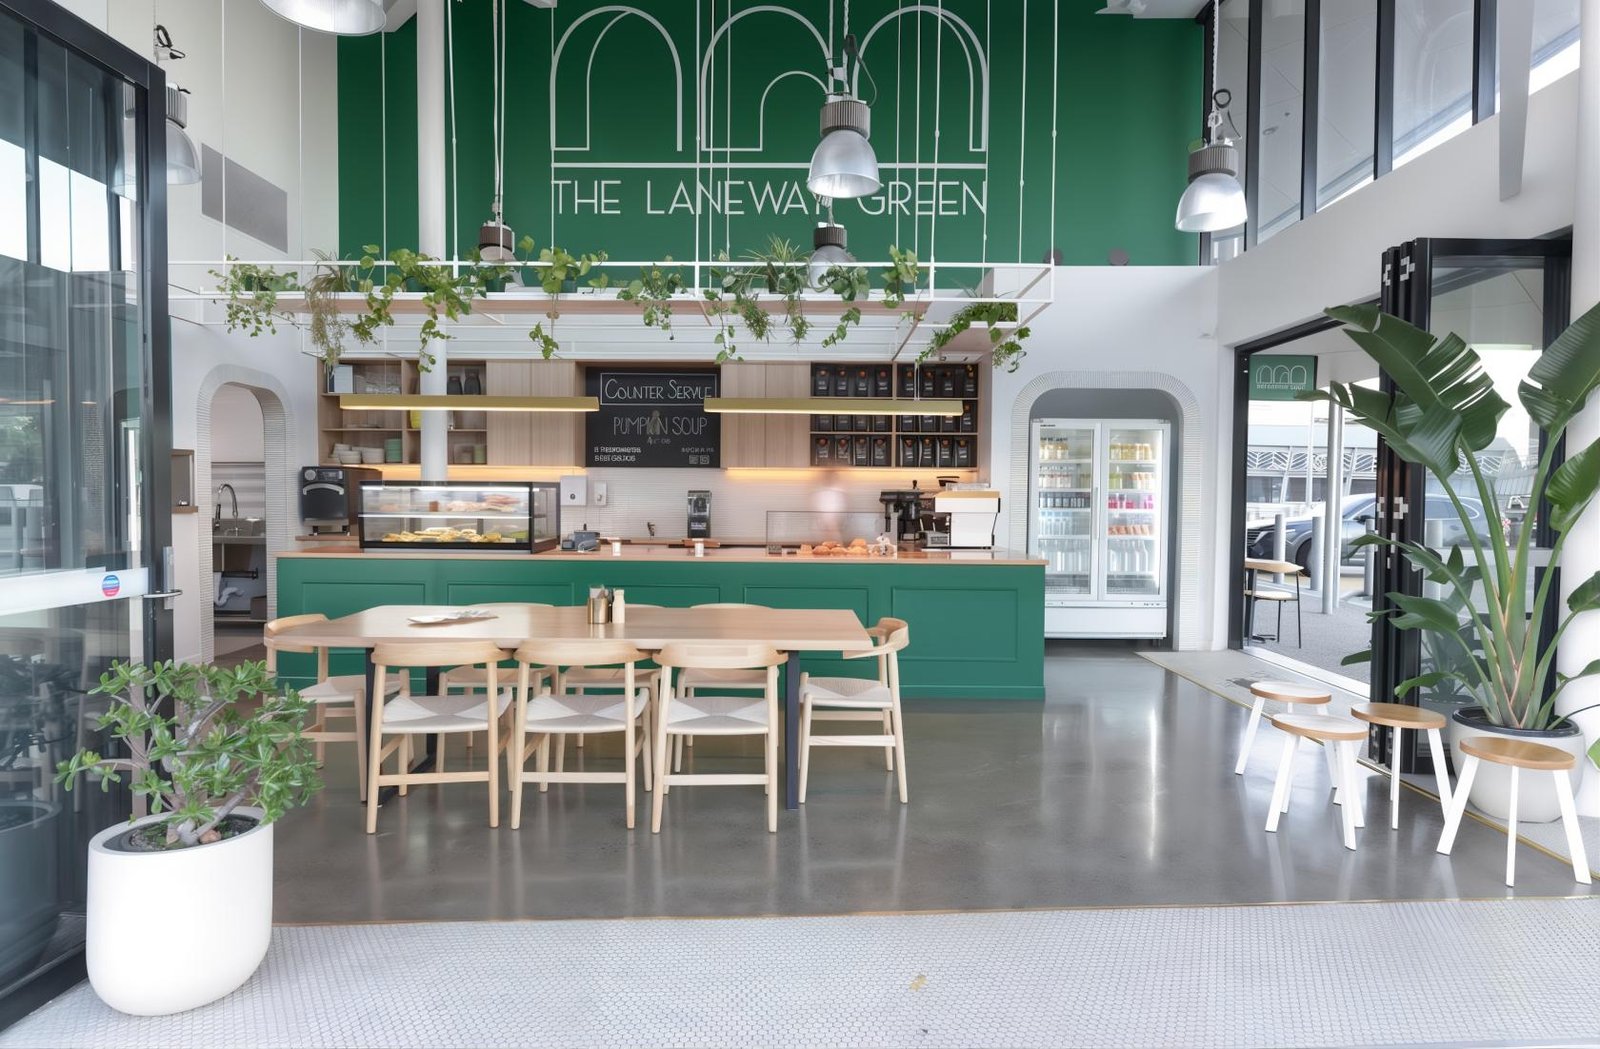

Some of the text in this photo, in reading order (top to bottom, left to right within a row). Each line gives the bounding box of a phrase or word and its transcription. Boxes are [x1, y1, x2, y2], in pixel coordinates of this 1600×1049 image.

[551, 180, 622, 215] THE
[857, 180, 987, 216] GREEN
[604, 378, 664, 400] COUNTER
[671, 416, 708, 435] SOUP
